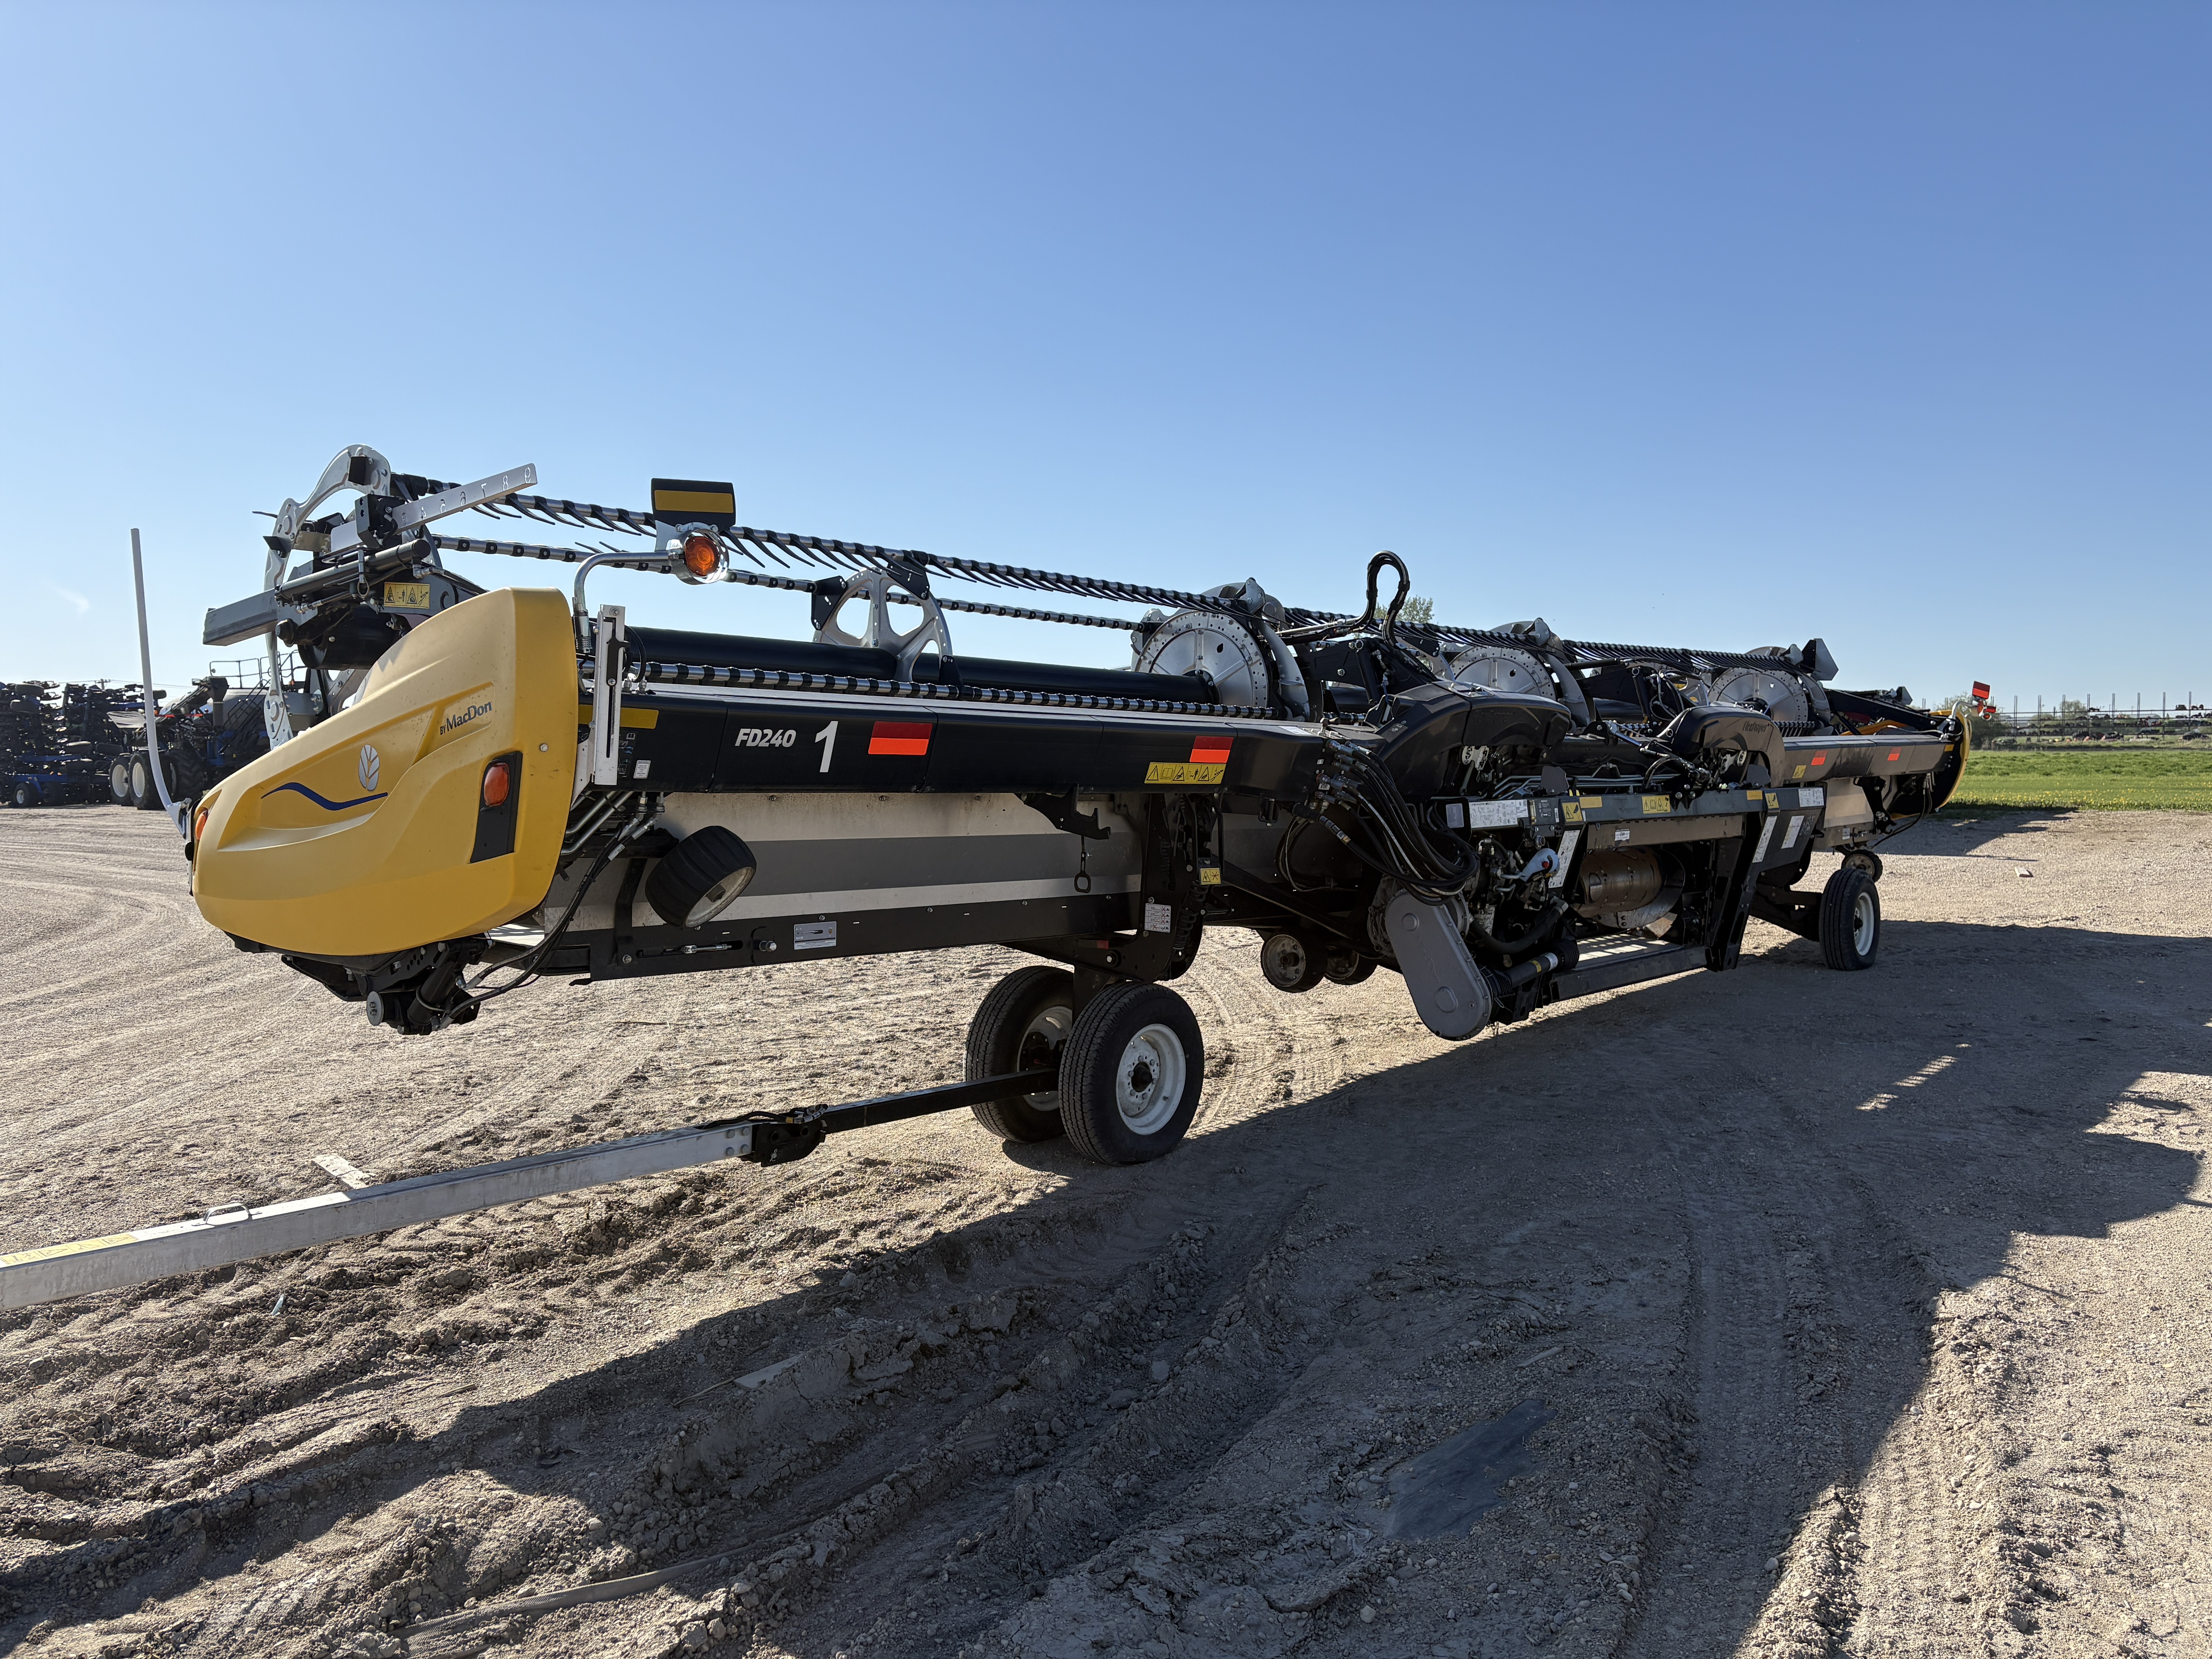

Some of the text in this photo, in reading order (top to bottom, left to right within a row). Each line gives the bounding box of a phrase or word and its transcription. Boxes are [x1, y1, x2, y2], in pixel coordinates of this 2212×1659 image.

[440, 701, 492, 735] BY MacDon
[735, 721, 838, 773] FD240 1
